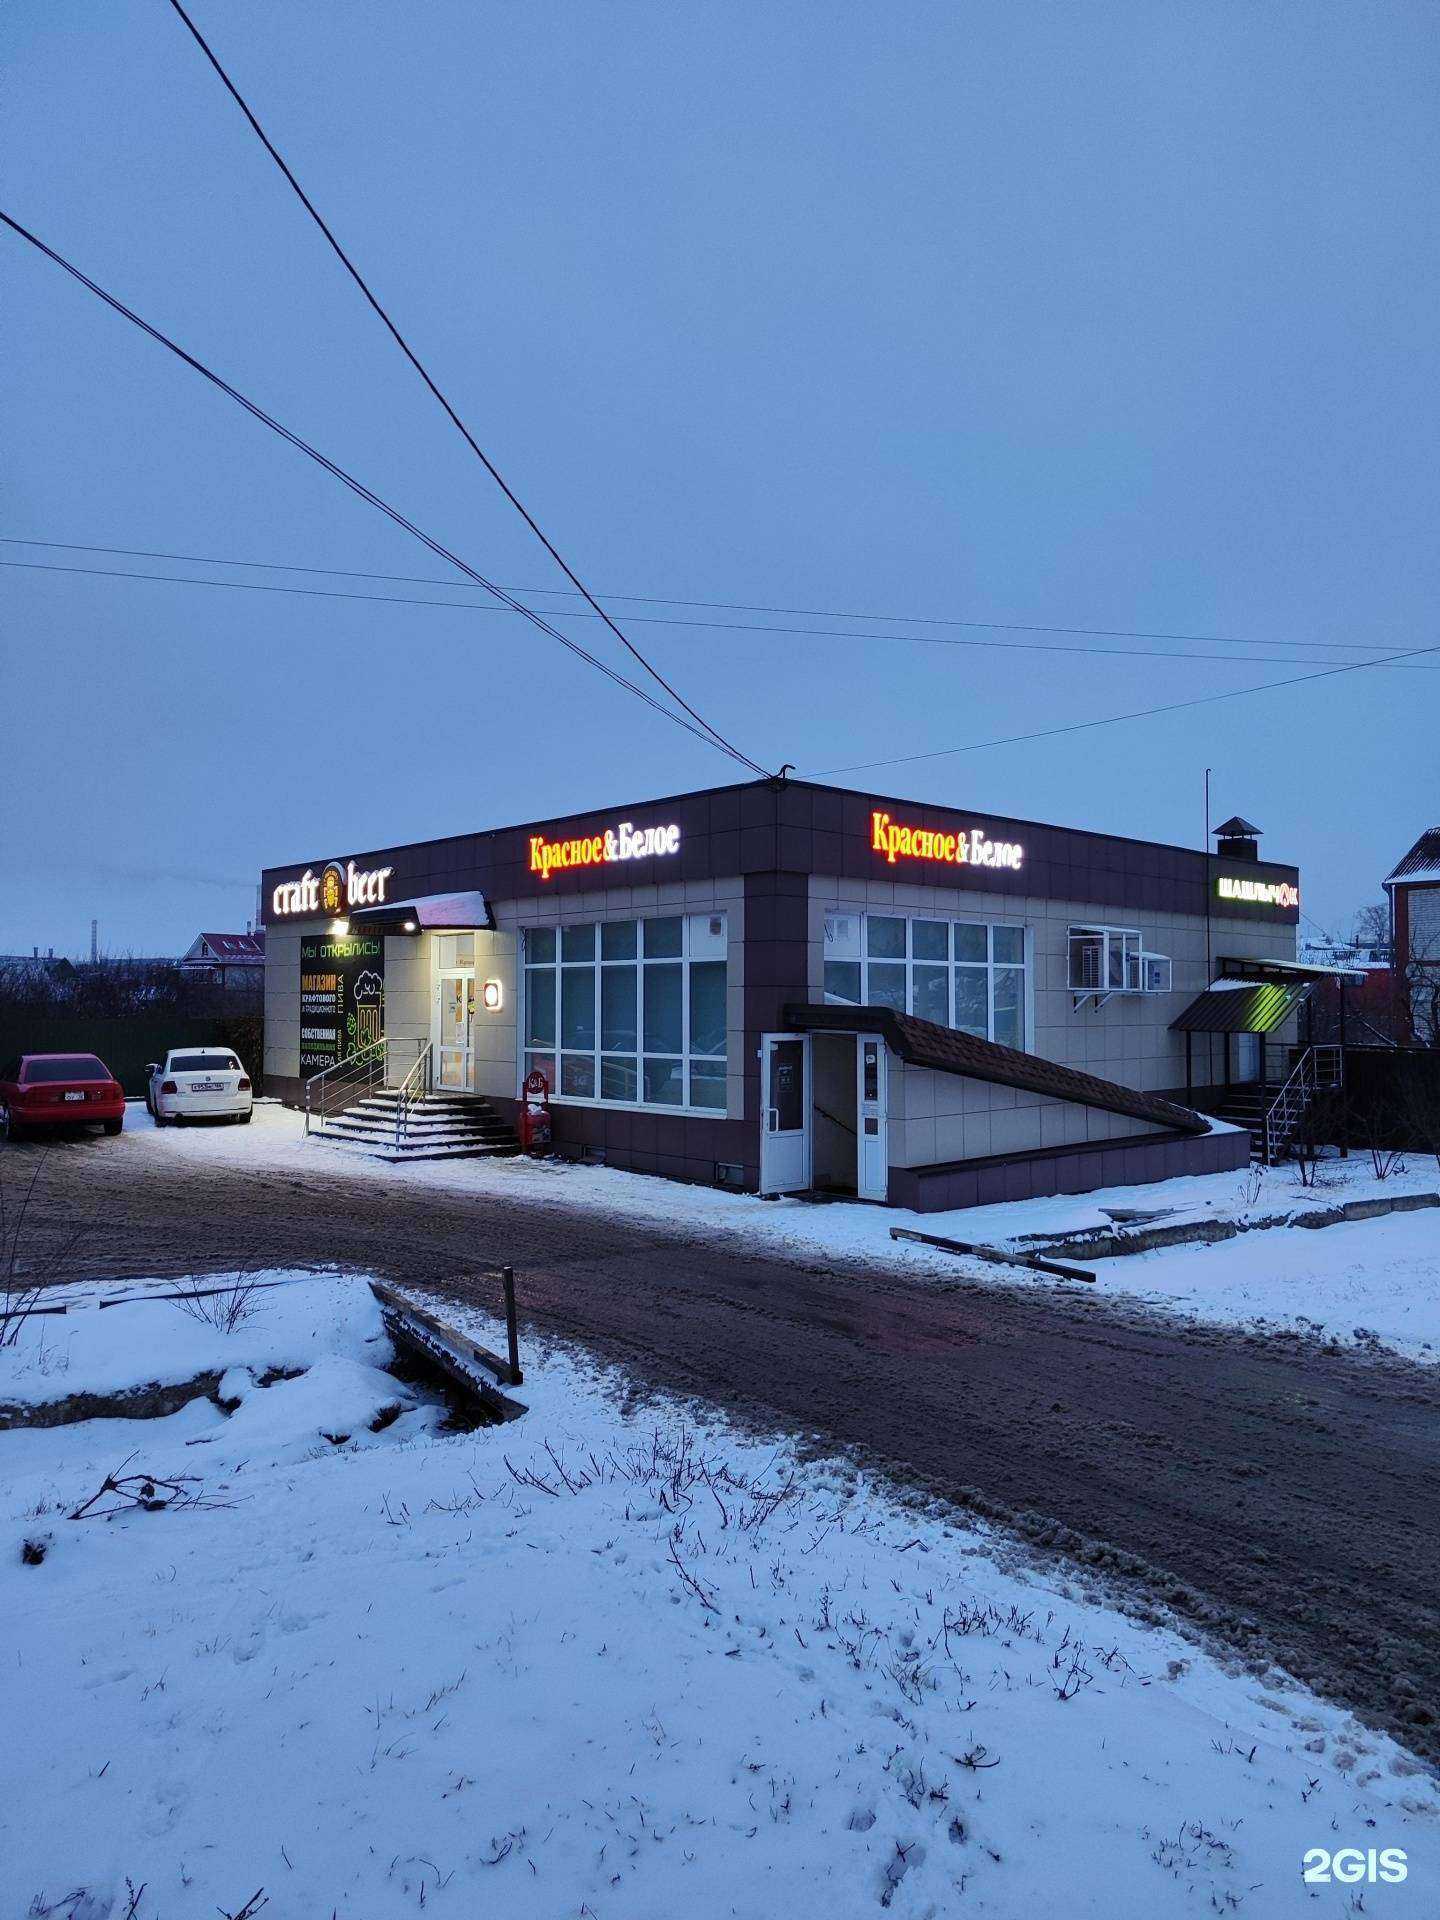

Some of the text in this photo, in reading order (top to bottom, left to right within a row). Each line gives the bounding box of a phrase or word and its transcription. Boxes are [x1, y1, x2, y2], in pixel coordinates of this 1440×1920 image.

[273, 859, 393, 915] craft beer
[302, 945, 317, 958] МЫ
[302, 974, 336, 991] МАГАЗИН
[302, 994, 336, 1003] КРАФТОВОГО
[301, 1054, 336, 1067] КАМЕРА
